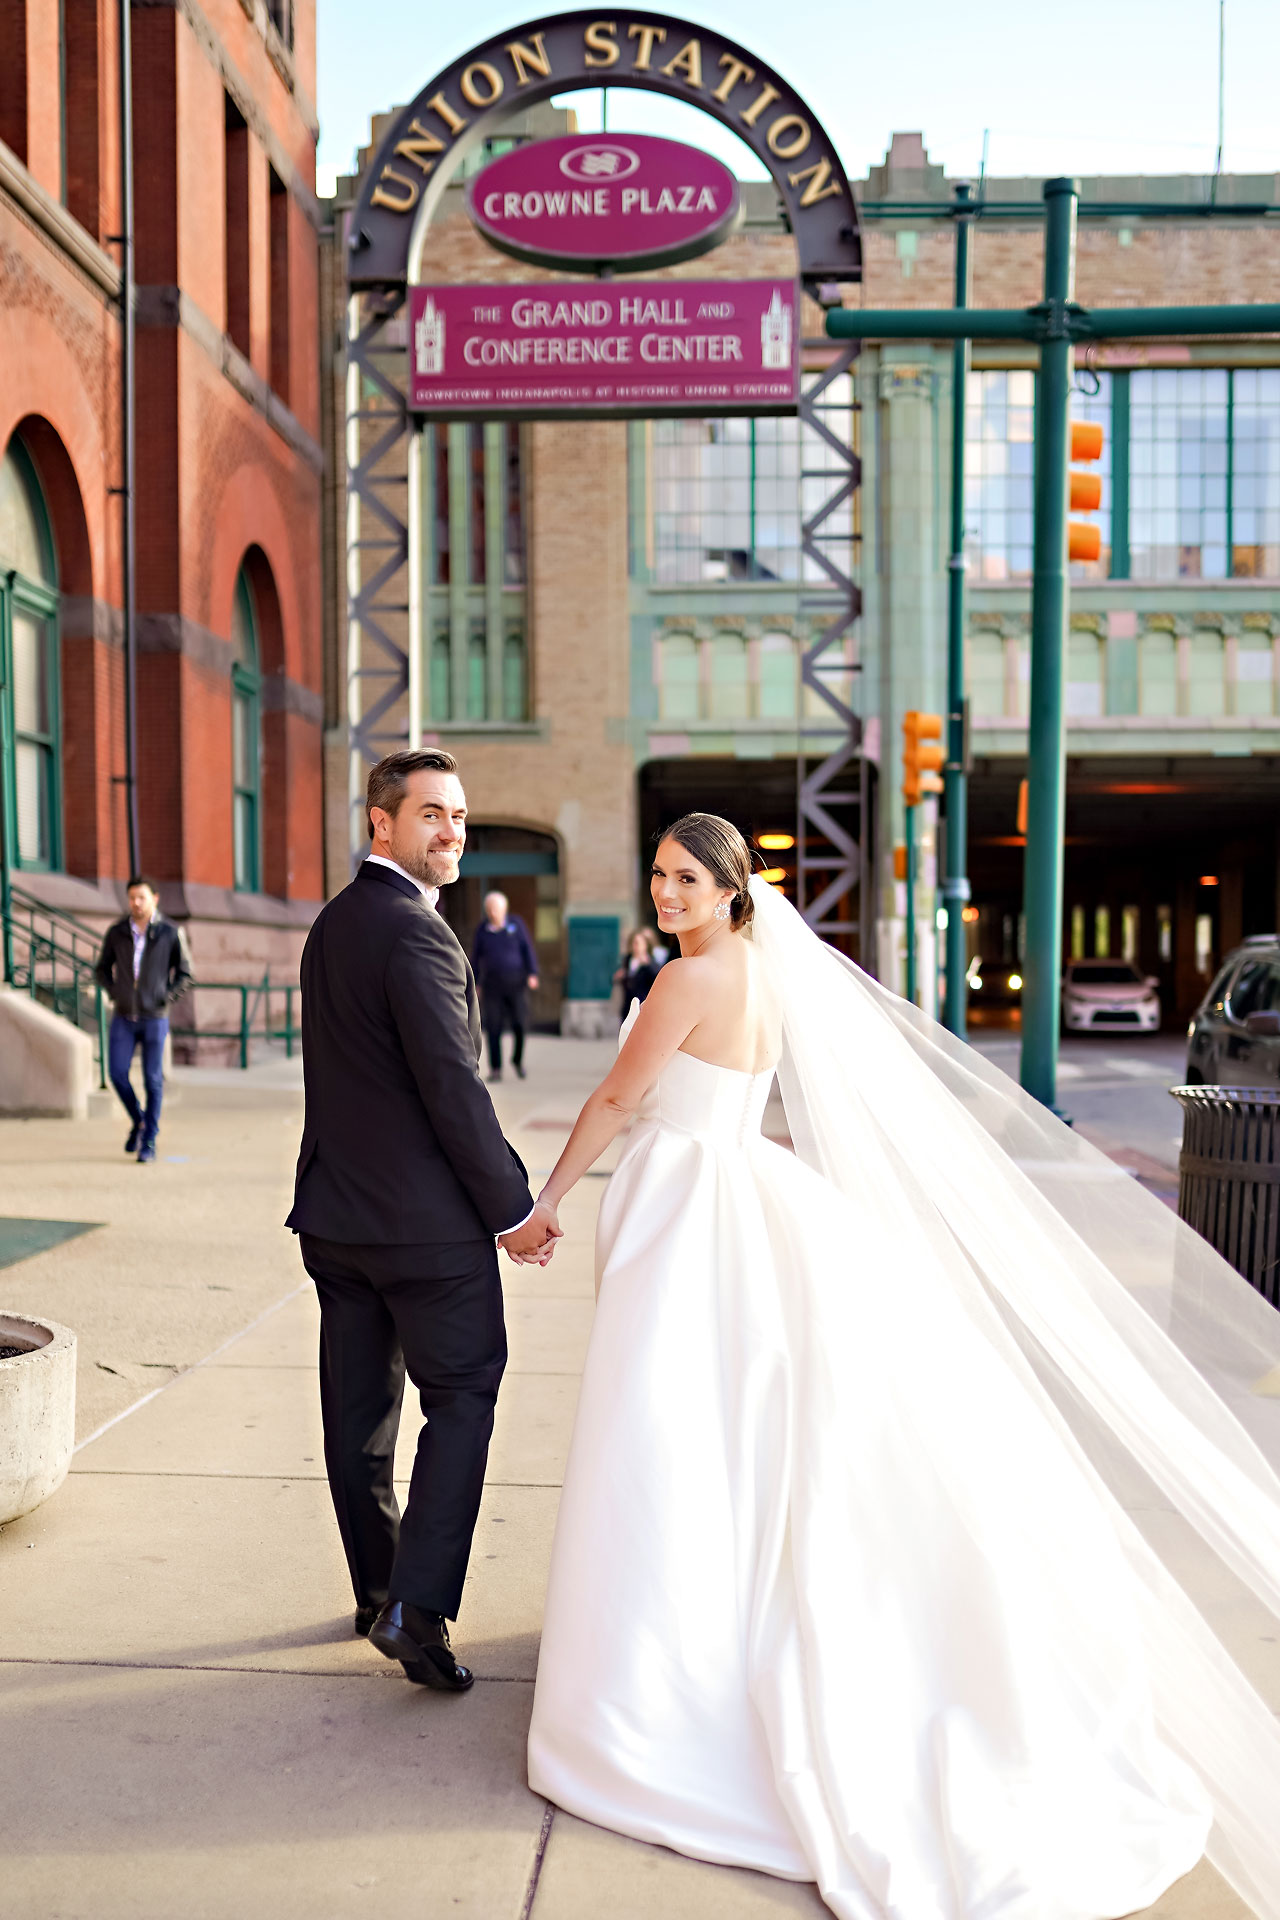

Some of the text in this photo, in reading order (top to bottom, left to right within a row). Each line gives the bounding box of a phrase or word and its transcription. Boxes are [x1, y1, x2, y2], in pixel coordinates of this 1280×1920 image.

[371, 21, 844, 213] UNION STATION
[483, 186, 718, 219] CROWNE PLAZA
[472, 307, 502, 324] THE
[696, 302, 734, 319] AND
[416, 383, 792, 401] DOWNTOWN INDIANAPOLIS AT HISTORIC UNION STATION
